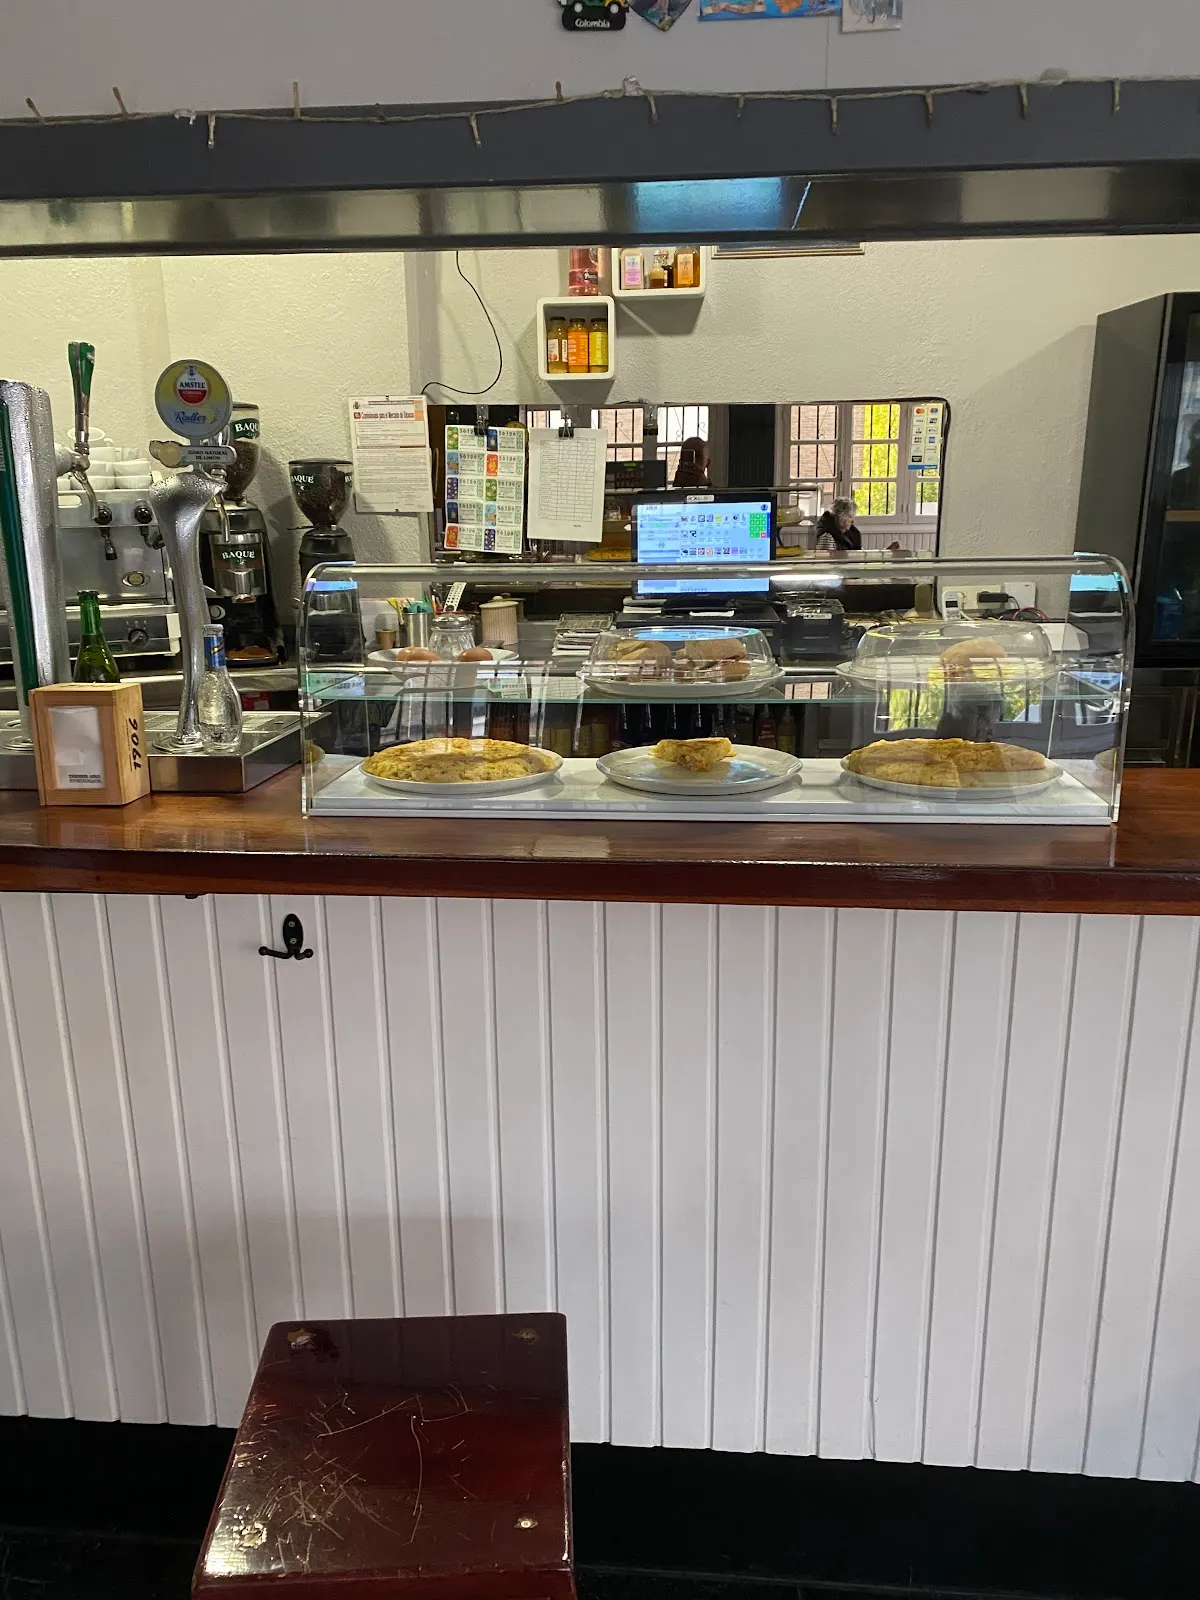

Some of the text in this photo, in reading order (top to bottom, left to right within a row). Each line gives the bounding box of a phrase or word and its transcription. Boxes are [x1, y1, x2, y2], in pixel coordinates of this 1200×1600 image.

[575, 18, 610, 28] Colombia
[179, 381, 206, 389] AMSTEL
[175, 410, 206, 424] Radler
[235, 422, 259, 433] BAQU
[222, 550, 256, 560] BAQUE
[128, 717, 142, 770] 1906
